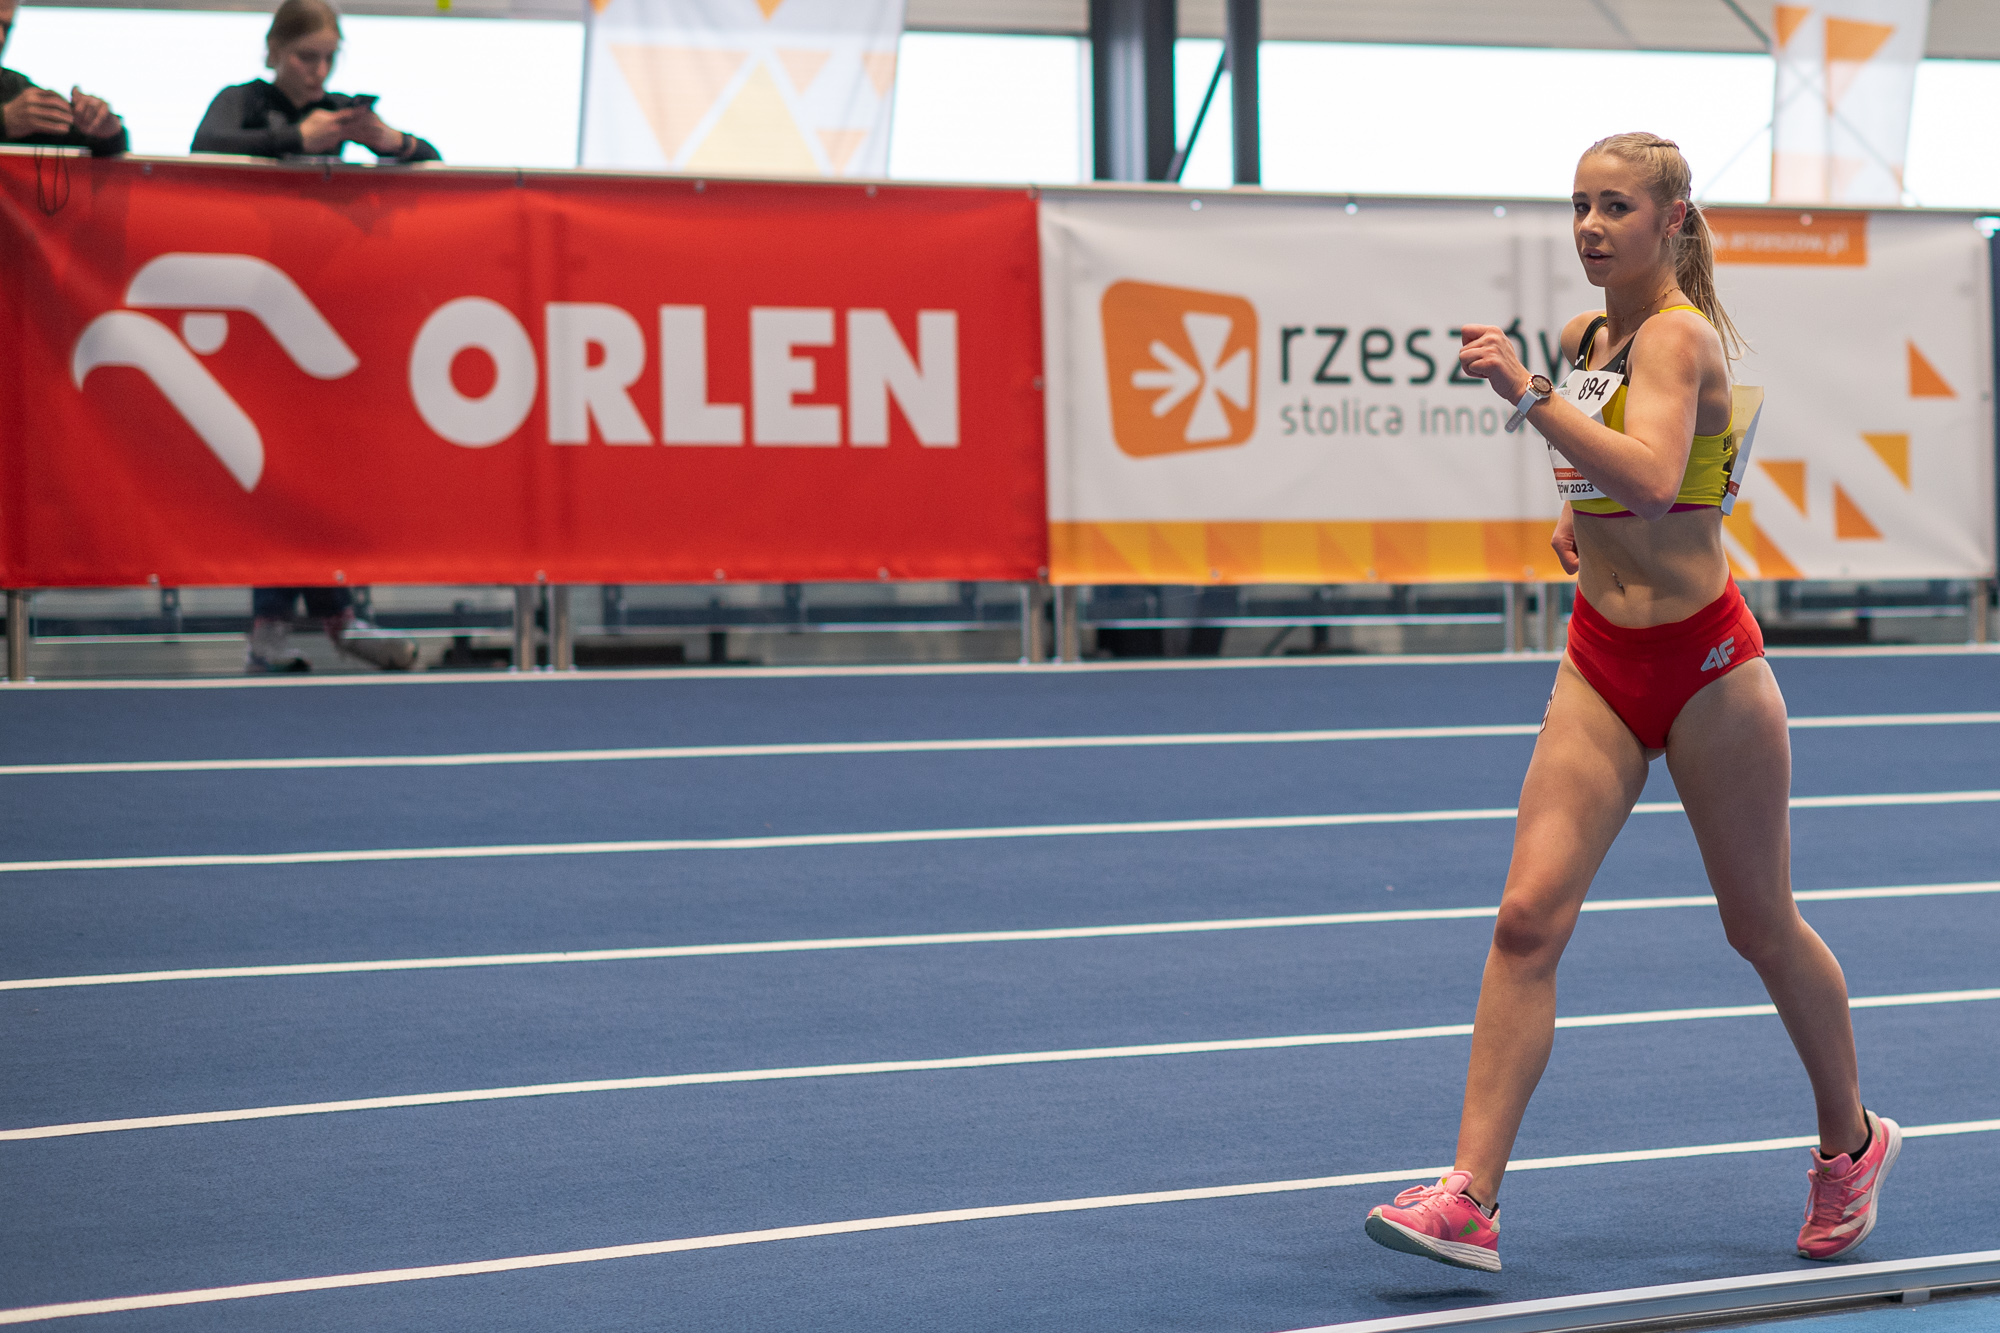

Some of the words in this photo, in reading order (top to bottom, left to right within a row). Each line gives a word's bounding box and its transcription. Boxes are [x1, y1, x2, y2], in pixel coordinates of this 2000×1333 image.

[408, 295, 960, 448] ORLEN
[1578, 376, 1611, 401] 894
[1280, 399, 1403, 437] stolica
[1570, 483, 1595, 494] 2023
[1700, 636, 1735, 672] 4F
